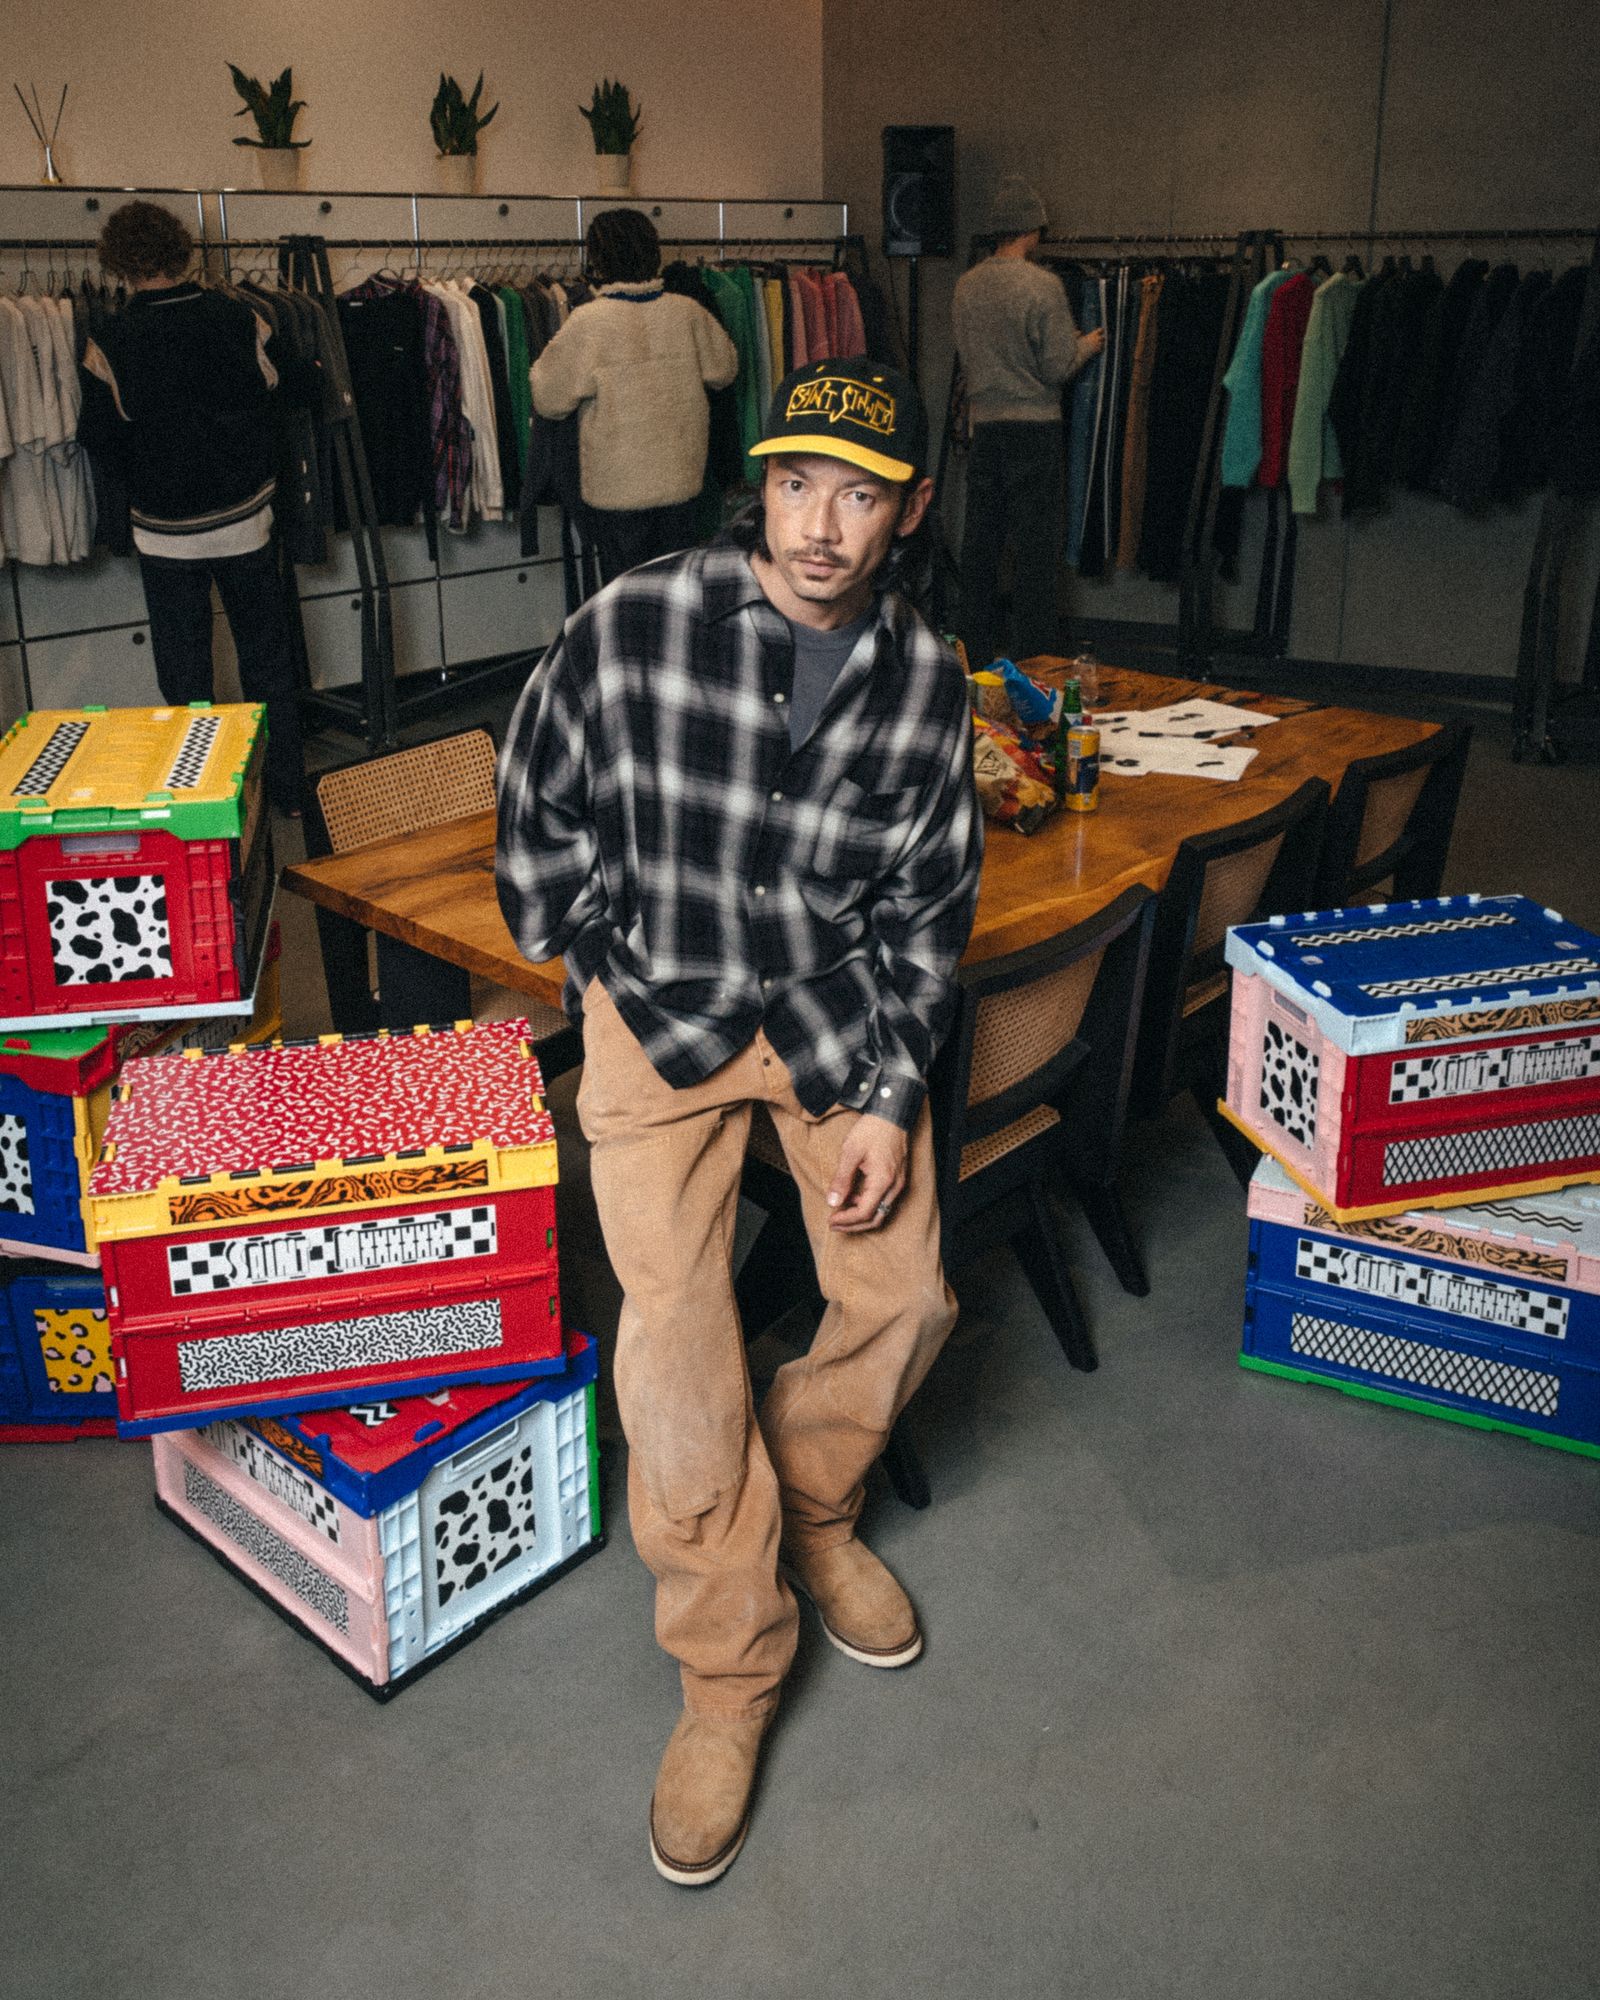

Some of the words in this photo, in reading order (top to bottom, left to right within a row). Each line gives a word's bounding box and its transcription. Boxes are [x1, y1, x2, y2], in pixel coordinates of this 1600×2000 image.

[1430, 1055, 1491, 1093] SAINT
[226, 1236, 310, 1284] SAINT
[1340, 1252, 1407, 1298] SAINT
